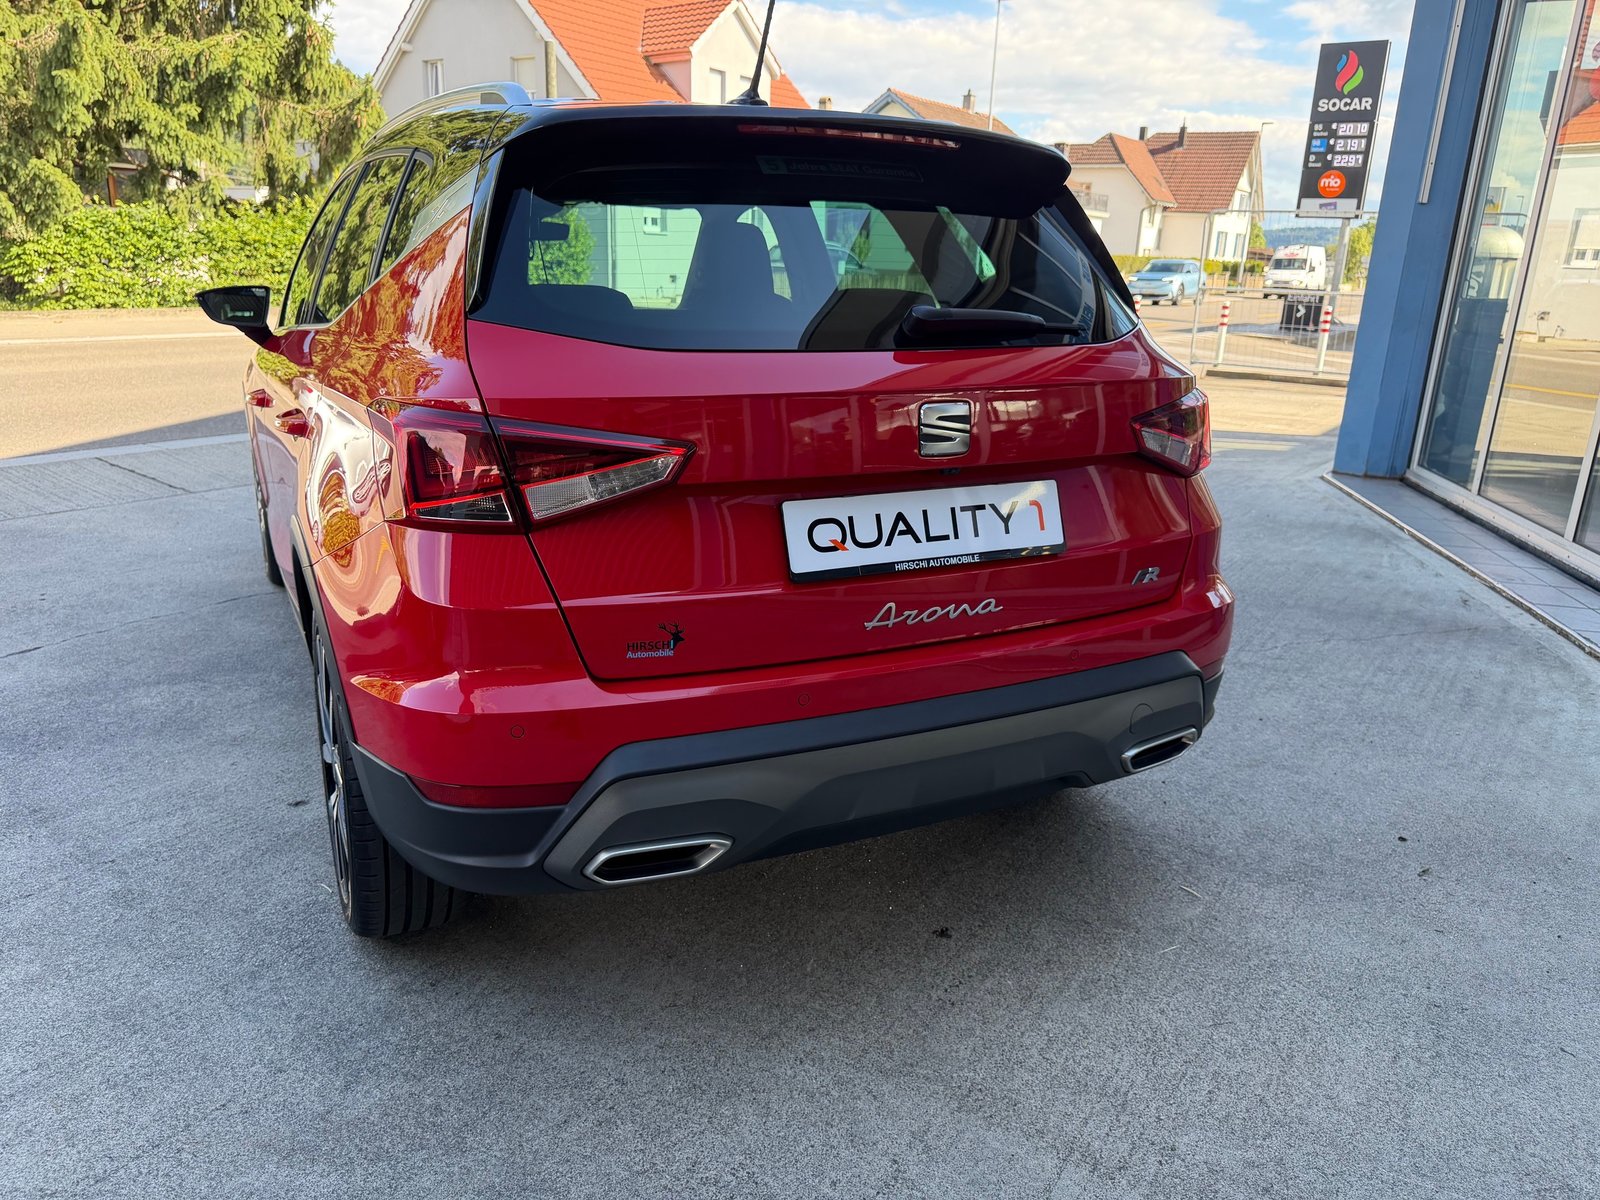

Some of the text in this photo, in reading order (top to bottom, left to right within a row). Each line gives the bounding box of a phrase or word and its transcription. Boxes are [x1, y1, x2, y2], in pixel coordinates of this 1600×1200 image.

[1317, 97, 1372, 112] SOCAR
[894, 554, 980, 572] HIRSCHI AUTOMOBILE
[864, 597, 1004, 631] Arona
[626, 649, 674, 659] Automobile
